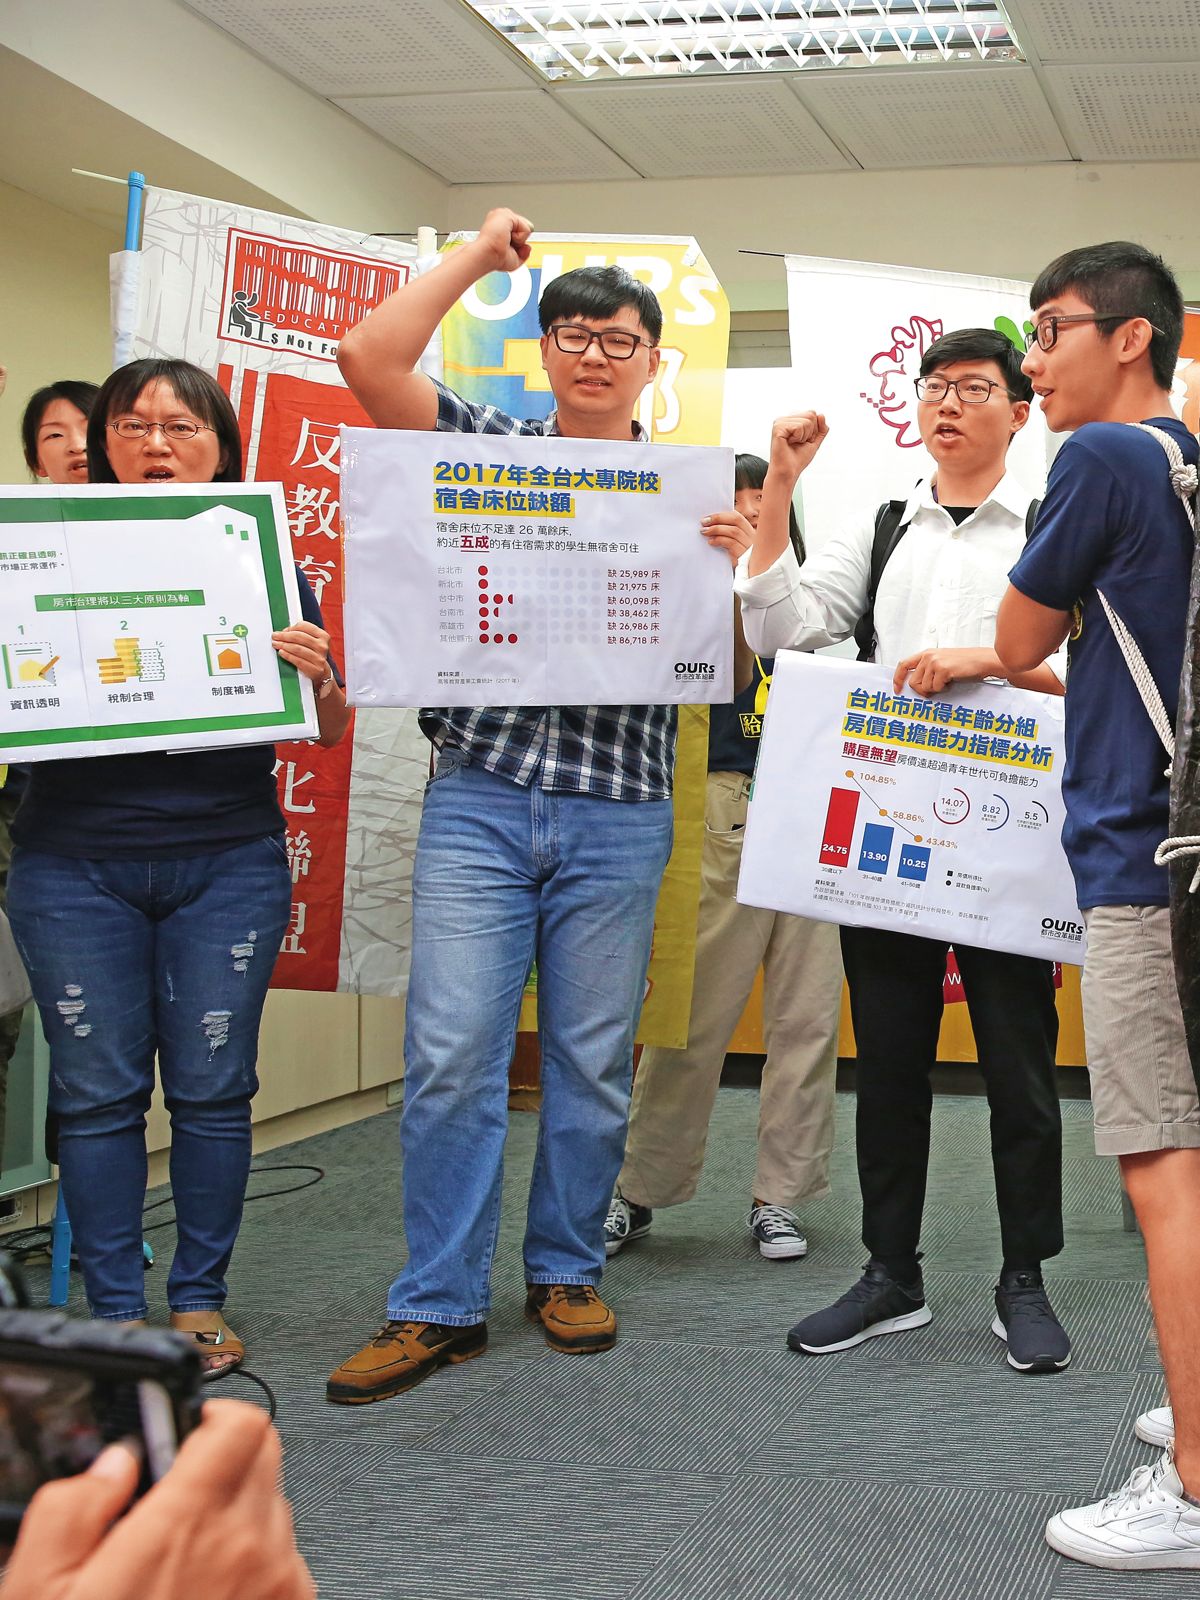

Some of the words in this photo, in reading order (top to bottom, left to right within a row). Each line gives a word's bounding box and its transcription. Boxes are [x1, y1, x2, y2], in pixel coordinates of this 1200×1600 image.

[264, 310, 349, 334] EDUCATI
[286, 334, 312, 351] Not
[435, 461, 659, 491] 2017年全台大專院校
[435, 487, 571, 513] 宿舍床位缺額
[436, 522, 516, 534] 宿舍床位不足達
[519, 525, 534, 535] 26
[619, 570, 649, 578] 25,989
[619, 583, 647, 591] 21,975
[619, 597, 649, 605] 60,098
[619, 610, 649, 618] 38,462
[120, 620, 128, 630] 2
[219, 616, 227, 626] 3
[18, 625, 25, 635] 1
[619, 623, 648, 631] 26,986
[619, 637, 647, 645] 86,718
[674, 662, 715, 673] OURs
[211, 684, 255, 697] 制度補強
[107, 691, 154, 703] 稅制合理
[10, 698, 60, 710] 資訊透明
[850, 687, 1036, 738] 台北市所得年齡分組
[844, 711, 1052, 767] 房價負擔能力指標分析
[859, 772, 897, 785] 104.85%
[941, 798, 965, 808] 14.07
[981, 804, 1001, 815] 8.82
[893, 811, 924, 823] 58.86%
[1024, 811, 1039, 821] 5.5
[926, 837, 958, 849] 43.43%
[822, 844, 848, 855] 24.75
[862, 850, 887, 861] 13.90
[902, 857, 927, 869] 10.25
[1041, 918, 1084, 934] OURs
